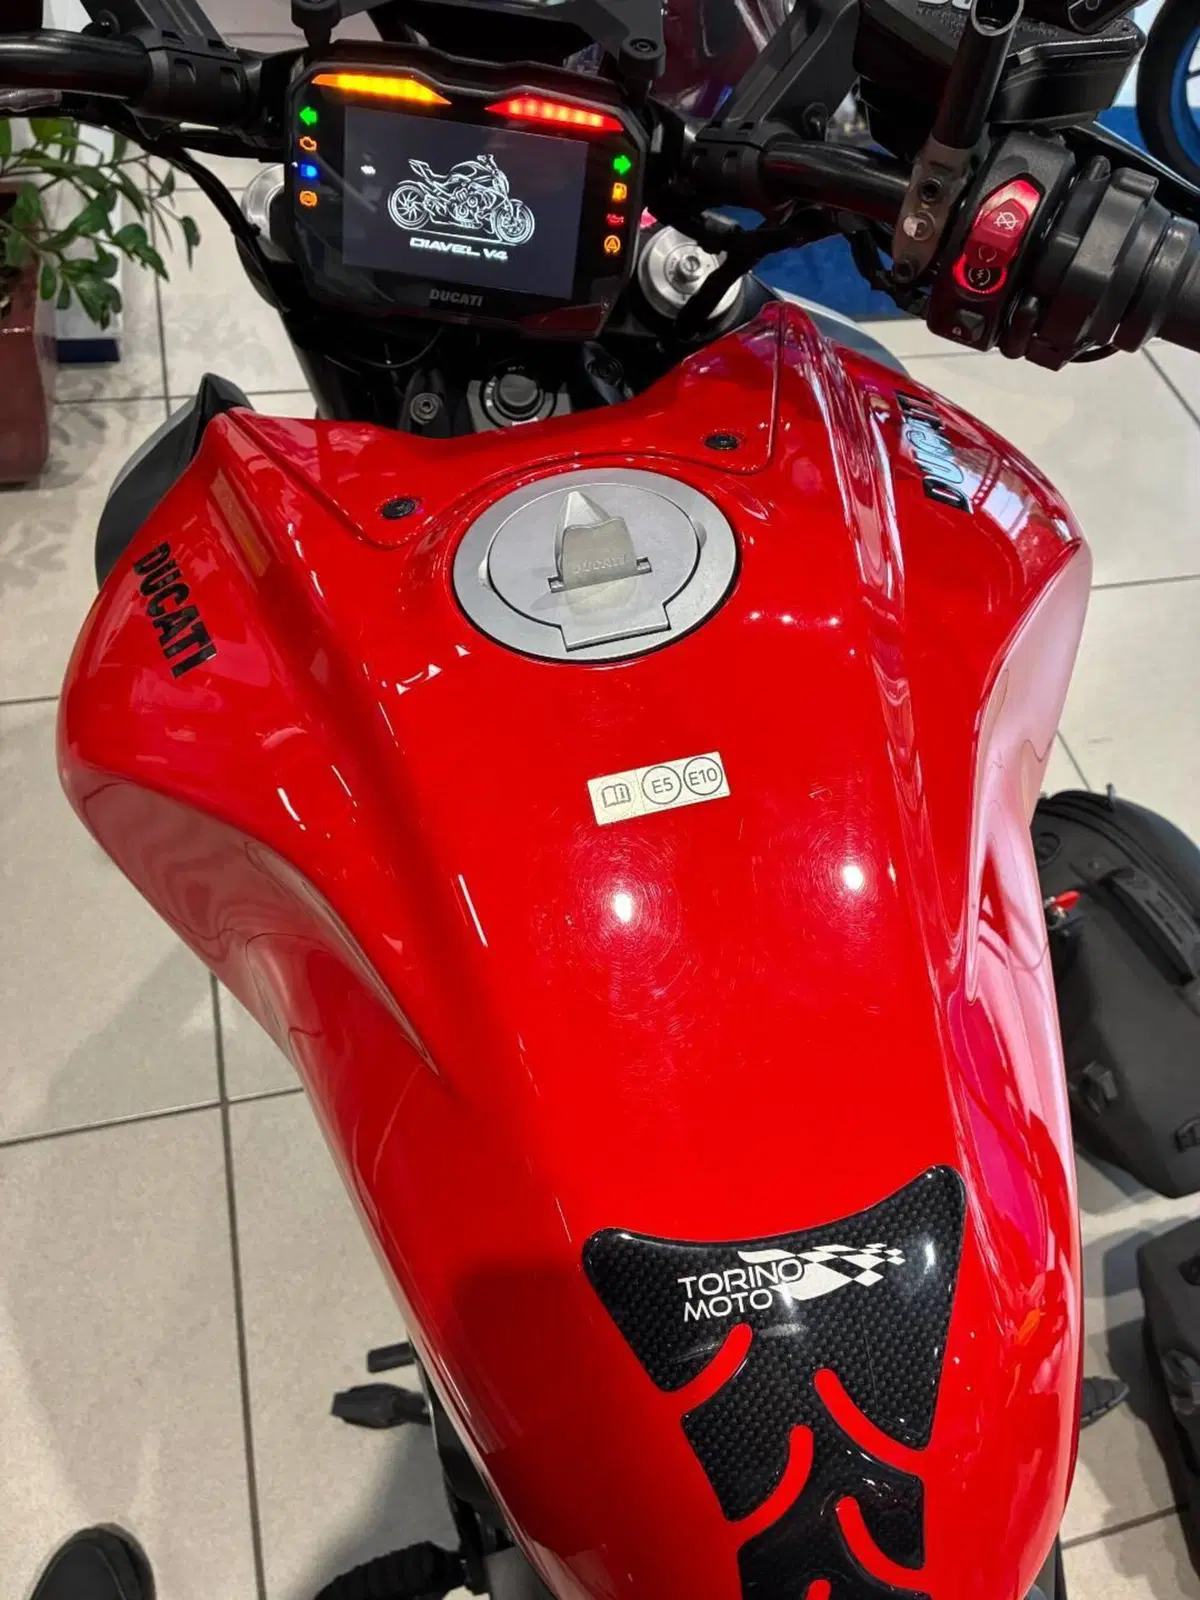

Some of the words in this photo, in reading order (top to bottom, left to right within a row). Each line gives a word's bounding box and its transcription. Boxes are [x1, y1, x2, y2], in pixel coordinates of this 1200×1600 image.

[409, 237, 481, 257] DIAVEL
[483, 247, 509, 261] V4
[429, 288, 484, 307] DUCATI
[132, 541, 217, 678] DUCATI
[651, 777, 674, 795] E5
[688, 767, 718, 787] E10
[677, 1258, 802, 1298] TORINO
[683, 1288, 773, 1323] MOTO
